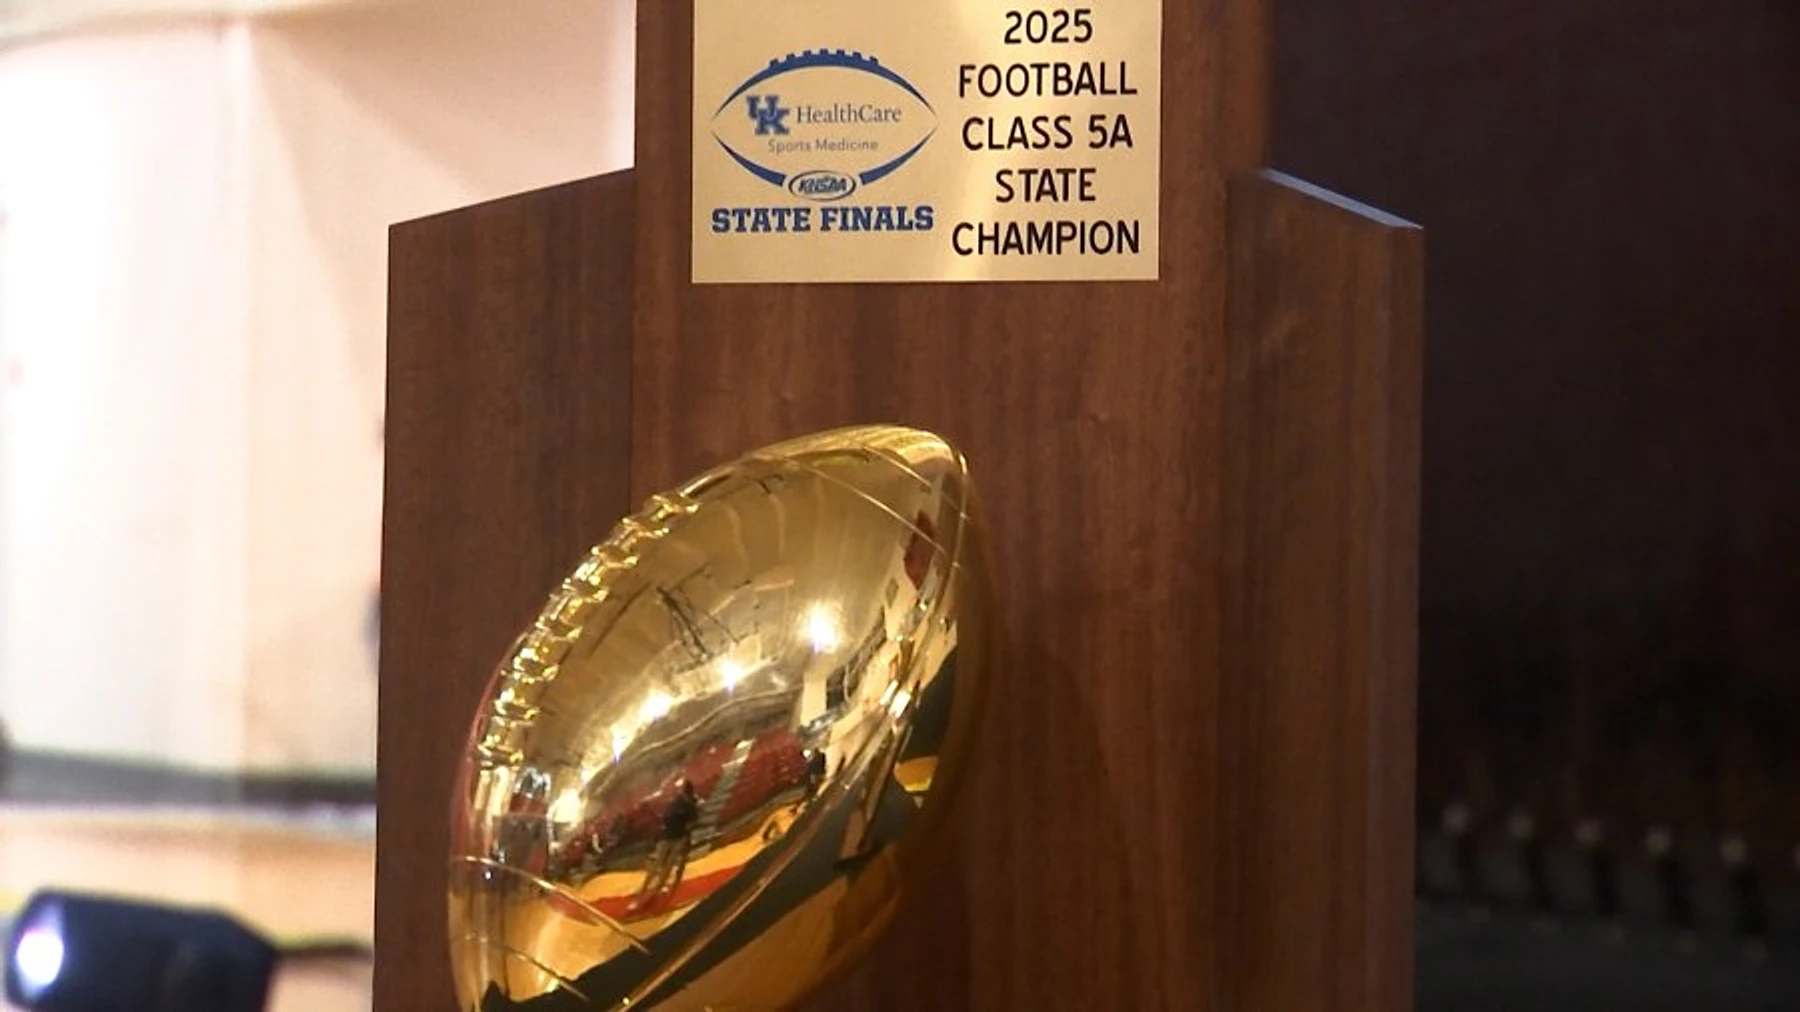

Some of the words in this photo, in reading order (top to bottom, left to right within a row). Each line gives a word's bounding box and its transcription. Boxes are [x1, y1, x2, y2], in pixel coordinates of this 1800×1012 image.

[1004, 9, 1093, 44] 2025
[959, 61, 1138, 98] FOOTBALL
[746, 95, 790, 135] UK
[796, 103, 902, 124] HealthCare
[962, 115, 1073, 151] CLASS
[1088, 114, 1133, 149] 5A
[768, 139, 812, 156] Sports
[816, 138, 879, 152] Medicine
[995, 168, 1097, 203] STATE
[712, 207, 811, 233] STATE
[820, 205, 934, 232] FINALS
[952, 220, 1140, 256] CHAMPION
